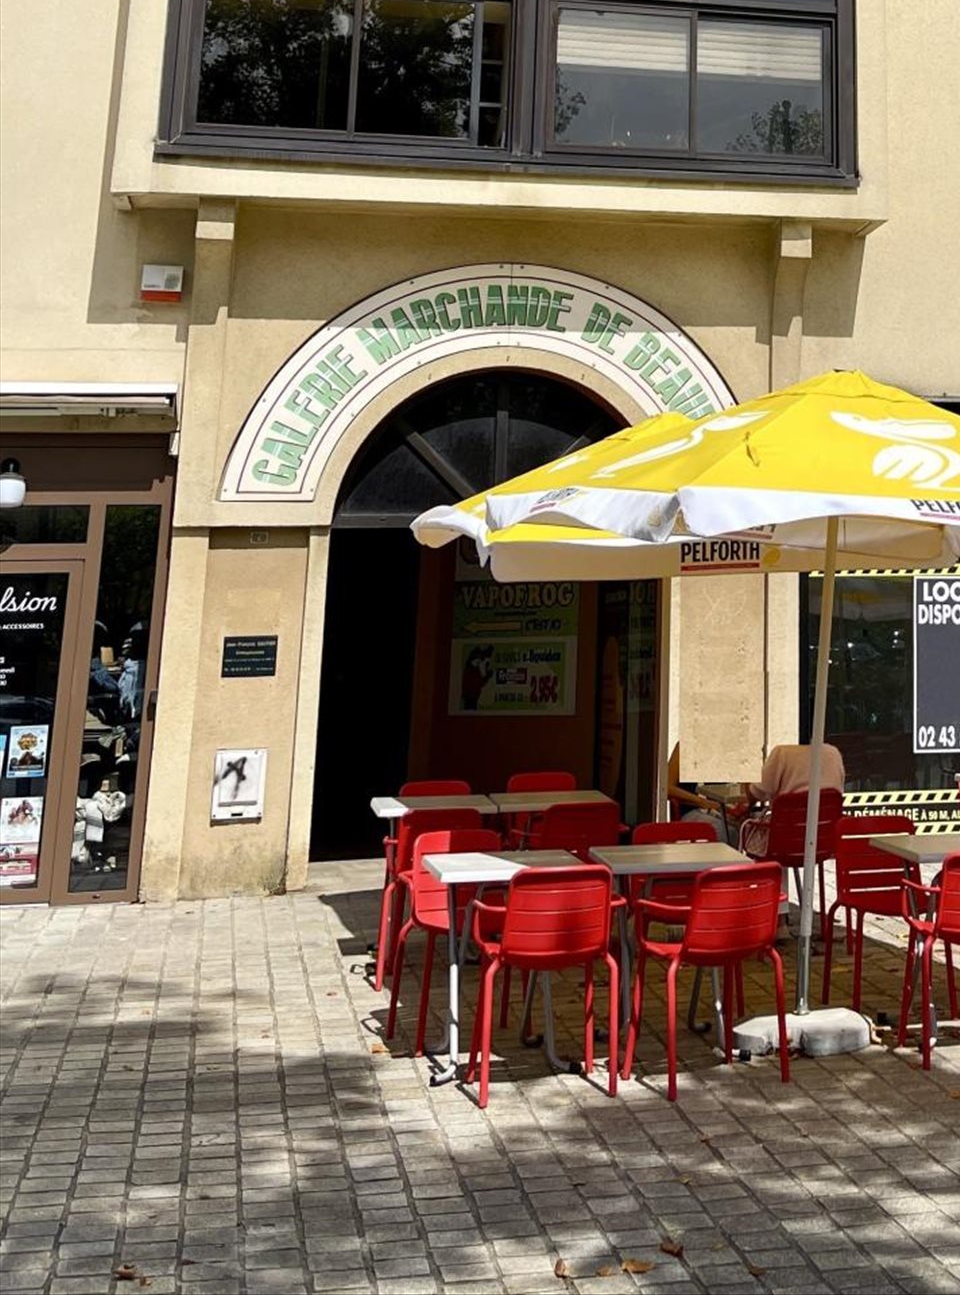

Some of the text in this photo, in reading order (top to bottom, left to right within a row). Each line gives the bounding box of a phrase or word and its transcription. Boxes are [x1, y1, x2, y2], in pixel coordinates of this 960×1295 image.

[251, 344, 368, 488] GALERIE
[355, 285, 575, 366] MARCHANDE
[579, 300, 634, 356] DE
[680, 541, 760, 563] PELFORTH
[918, 725, 936, 747] 02
[938, 725, 956, 747] 43
